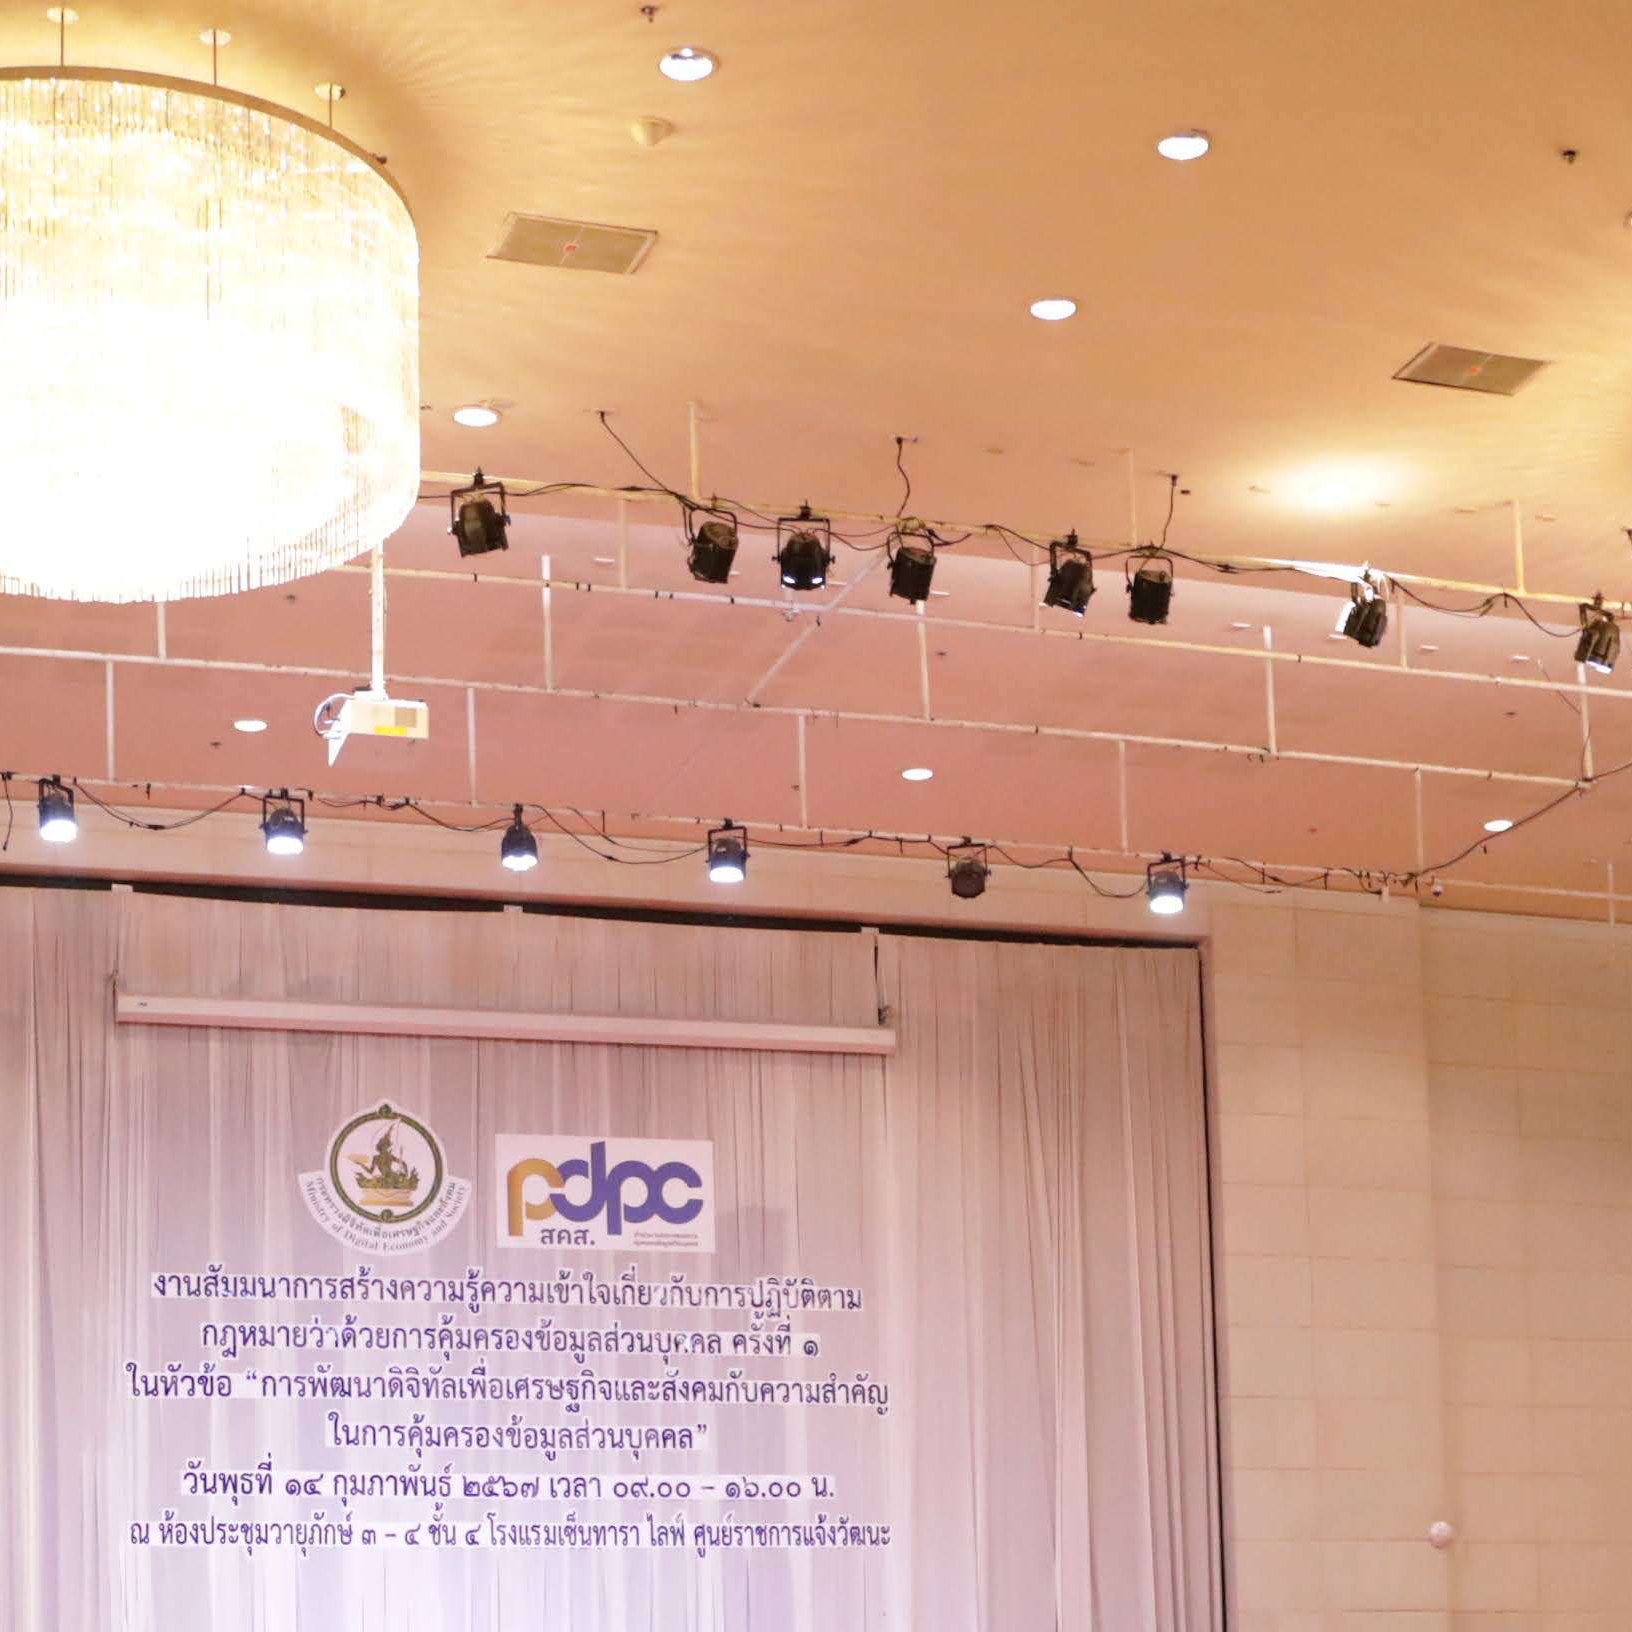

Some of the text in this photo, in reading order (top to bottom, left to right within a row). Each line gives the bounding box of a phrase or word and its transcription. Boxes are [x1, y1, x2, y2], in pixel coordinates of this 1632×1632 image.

[507, 1141, 703, 1236] pdpc
[331, 1220, 343, 1233] of
[343, 1231, 378, 1251] Digital
[382, 1233, 429, 1252] Economy
[431, 1218, 449, 1237] and
[540, 1228, 595, 1246] สคส.
[732, 1311, 792, 1355] ครั้งที่
[802, 1338, 819, 1356] ๑
[125, 1361, 233, 1398] ในหัวข้อ
[182, 1452, 274, 1506] วันพุธที่
[284, 1476, 325, 1496] ๑๔
[332, 1462, 454, 1507] กุมภาพันธ์
[462, 1474, 540, 1498] ๒๕๖๗
[549, 1475, 602, 1499] เวลา
[612, 1475, 692, 1500] ๐๙.๐๐
[724, 1475, 802, 1500] ๑๖.๐๐
[810, 1474, 835, 1499] น.
[129, 1521, 150, 1546] ณ
[158, 1508, 354, 1557] ห้องประชุมวายุภักษ์
[360, 1528, 377, 1546] ๓
[403, 1523, 422, 1546] ๔
[428, 1501, 457, 1547] ชั้น
[464, 1523, 483, 1546] ๔
